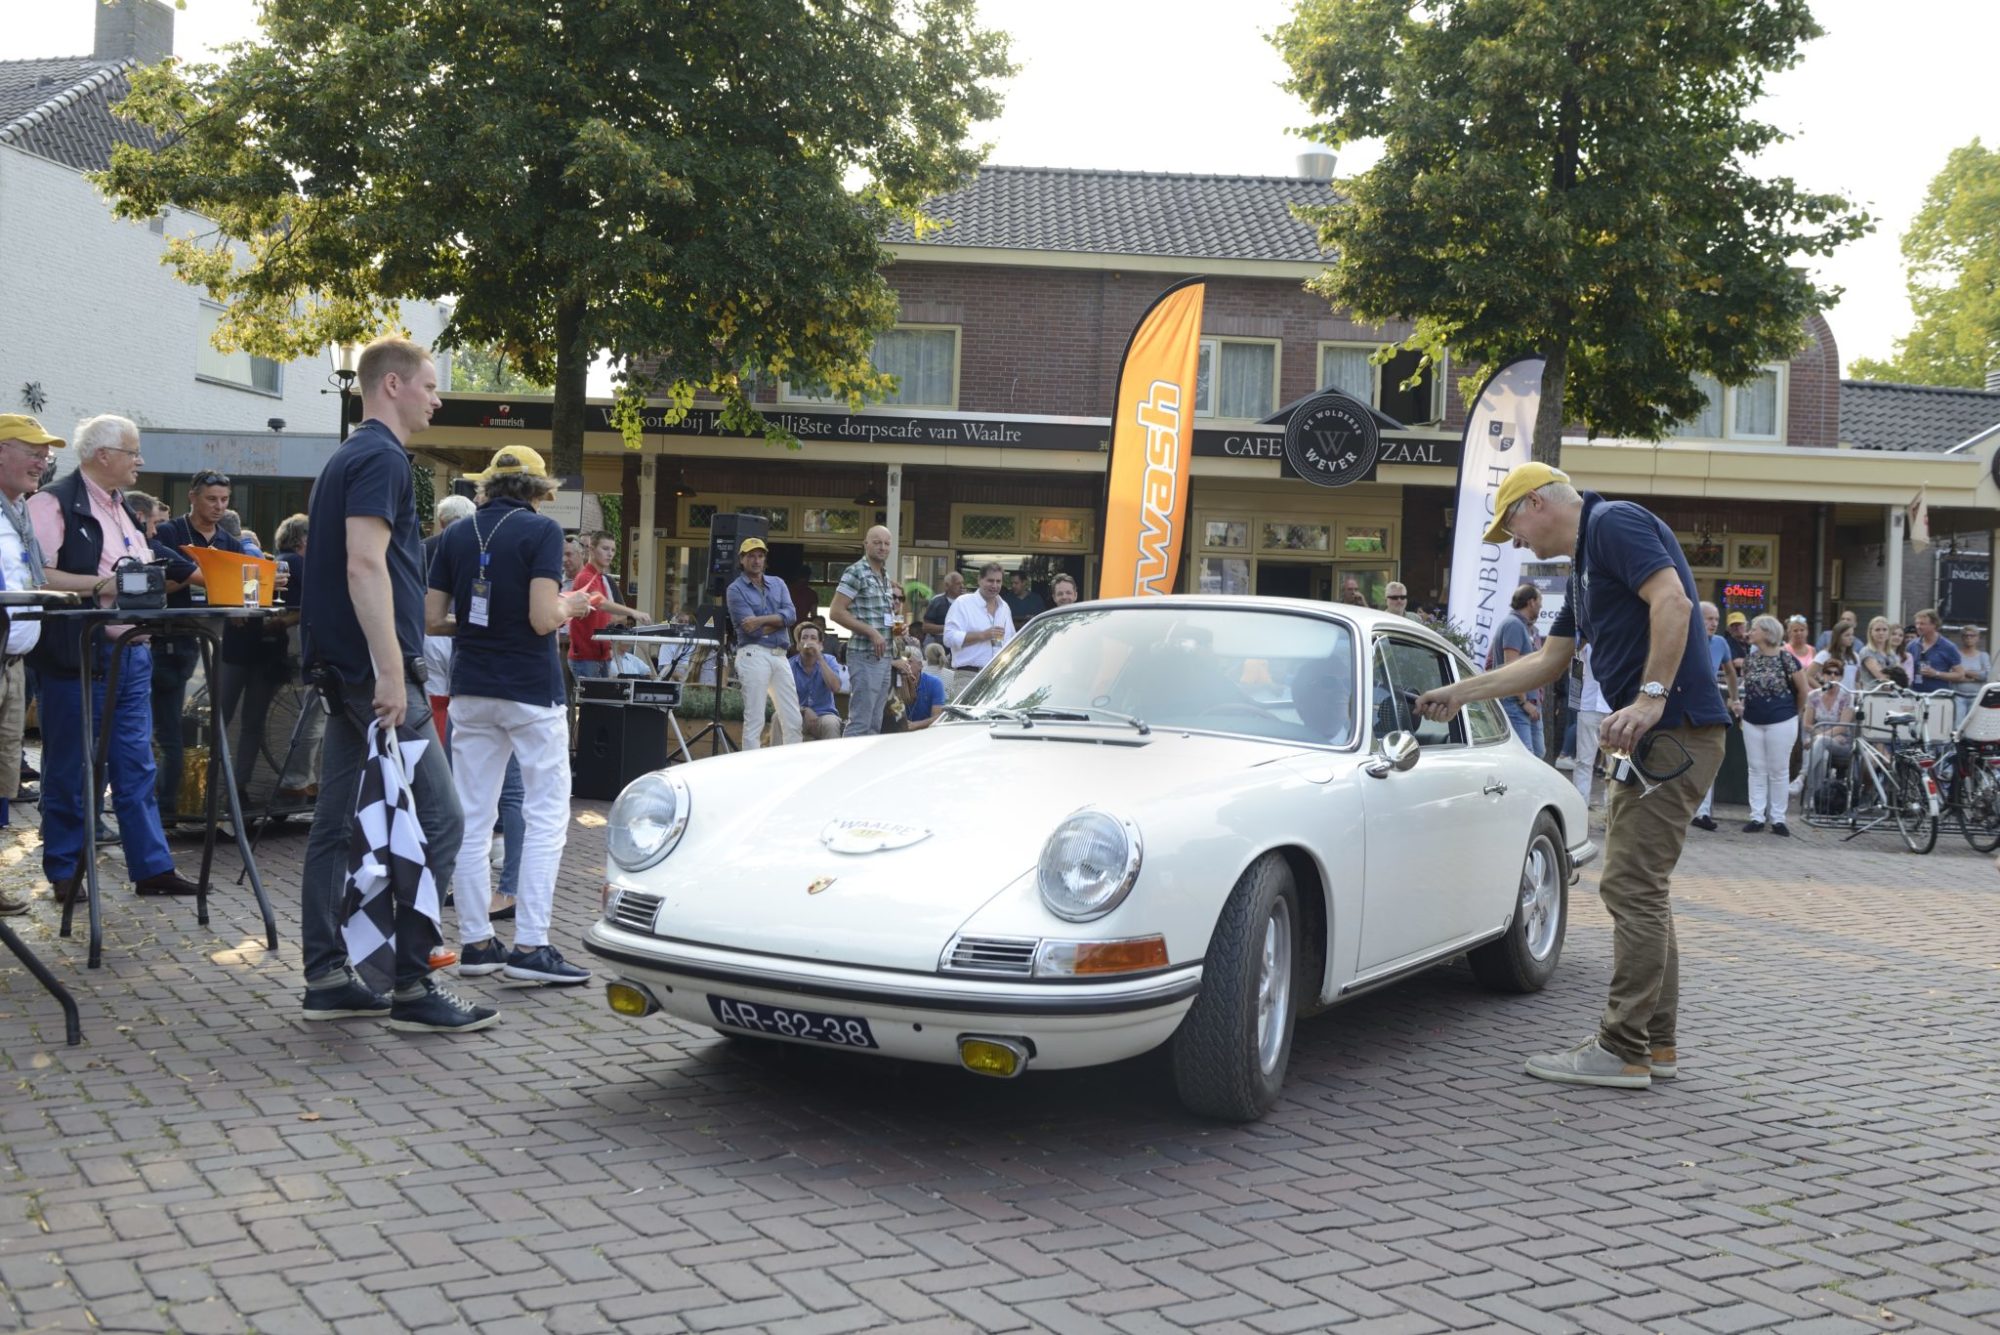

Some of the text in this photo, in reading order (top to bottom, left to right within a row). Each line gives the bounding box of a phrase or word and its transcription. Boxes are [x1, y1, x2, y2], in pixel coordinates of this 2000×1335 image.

[838, 417, 922, 443] dorpscafe
[929, 426, 957, 440] van
[963, 423, 1022, 442] Waalre
[1303, 410, 1361, 435] DE WOLDERSE
[1224, 437, 1282, 457] CAFE
[1313, 430, 1350, 456] W
[1380, 442, 1442, 462] ZAAL
[1306, 448, 1357, 472] WEVER
[720, 999, 869, 1047] AR-82-38
